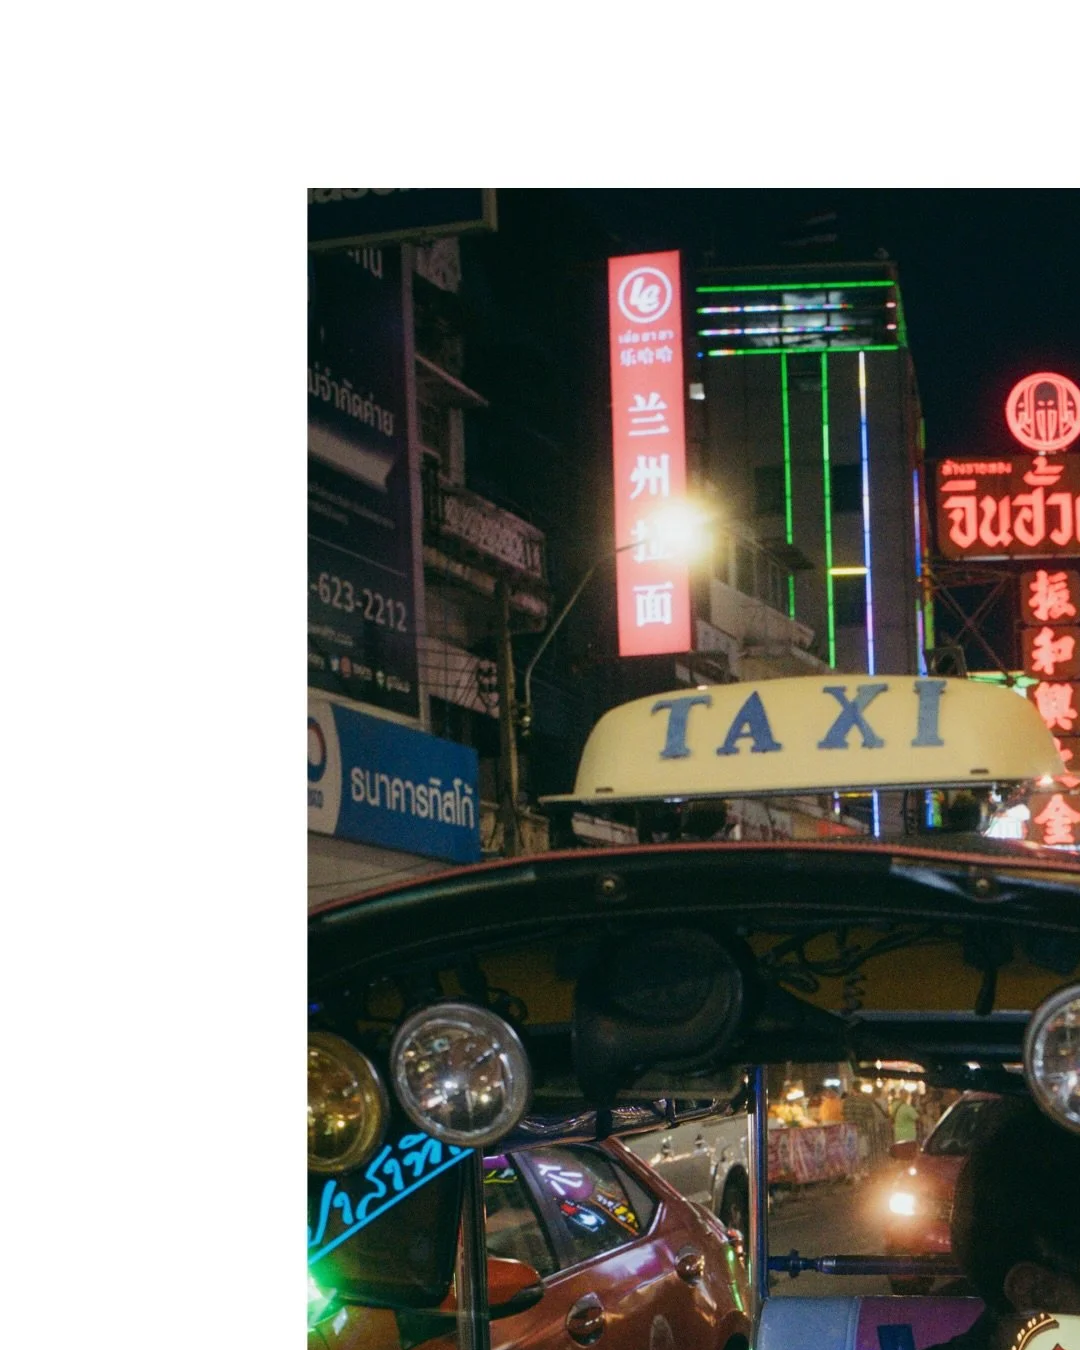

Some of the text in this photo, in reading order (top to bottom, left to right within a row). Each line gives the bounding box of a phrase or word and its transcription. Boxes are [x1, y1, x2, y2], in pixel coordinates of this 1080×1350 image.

[651, 680, 947, 759] TAXI
[350, 766, 475, 830] ธนาคารทิสโก้
